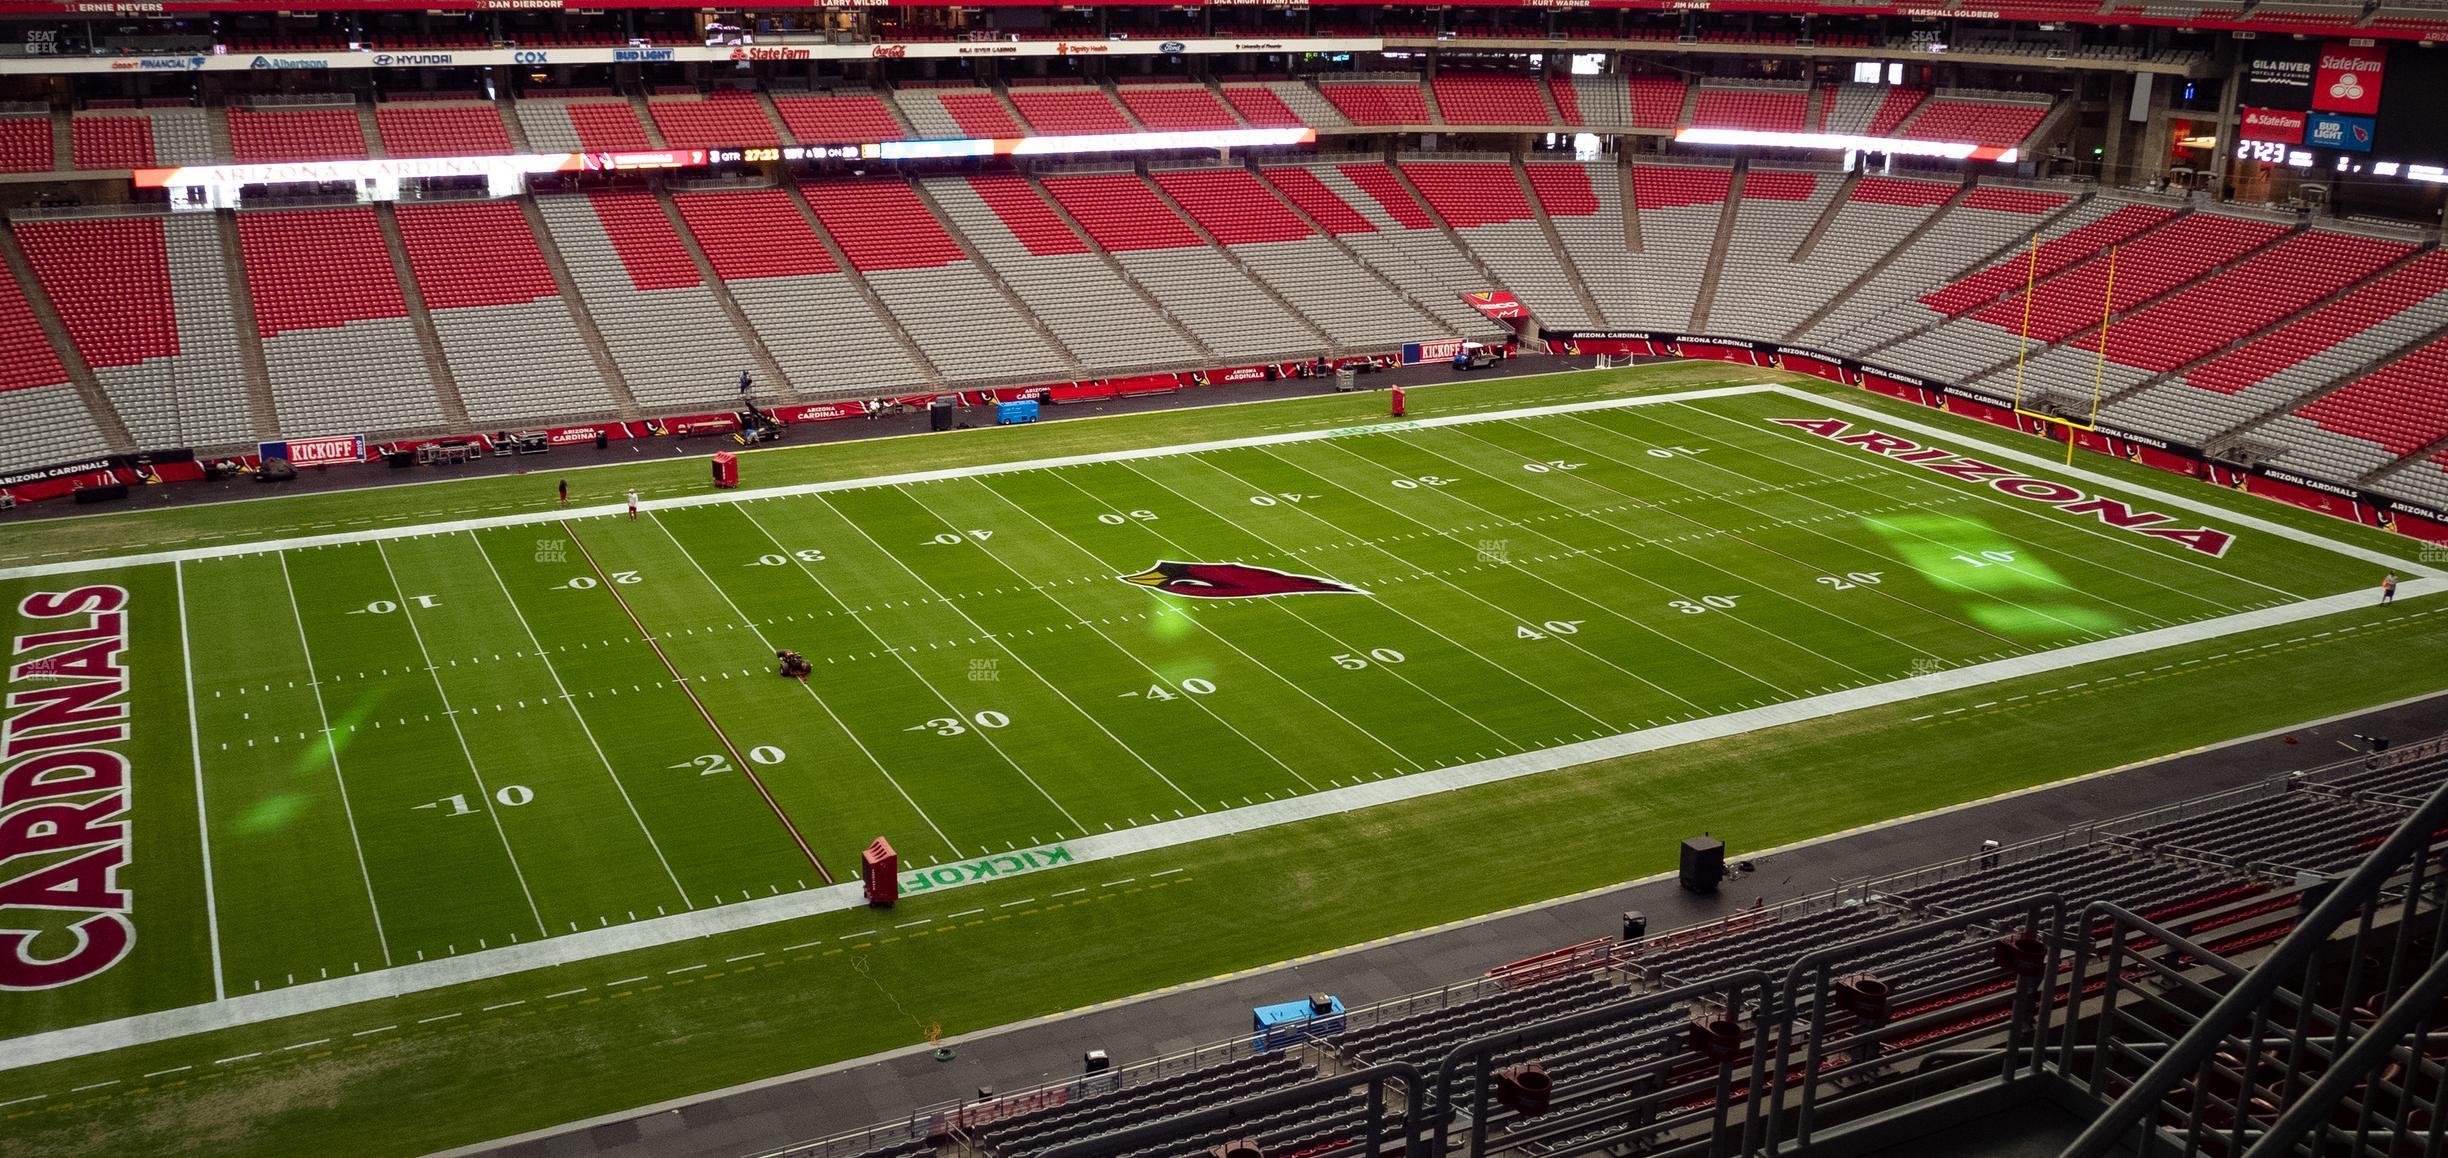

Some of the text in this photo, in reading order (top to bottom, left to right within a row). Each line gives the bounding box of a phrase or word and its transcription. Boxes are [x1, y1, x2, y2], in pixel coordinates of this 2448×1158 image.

[79, 3, 115, 12] ERNIE
[117, 3, 163, 12] NEVERS
[512, 0, 564, 8] DIERDORF
[1907, 8, 1953, 17] MARSHALL
[1954, 9, 2000, 18] GOLDBERG
[1070, 45, 1089, 53] Dignity
[1164, 43, 1181, 51] Ford
[396, 54, 452, 63] HYUNDAI
[514, 51, 548, 62] COX
[616, 51, 672, 61] BUD LIGHT
[140, 60, 186, 70] FINANCIAL
[272, 57, 328, 69] Albertsons
[2252, 60, 2311, 72] GILA RIVER
[2319, 122, 2341, 131] BUD
[2314, 129, 2344, 139] LIGHT
[721, 152, 741, 162] QTR
[744, 149, 780, 161] 27:23
[2237, 140, 2286, 163] 27:23
[211, 163, 341, 183] ARIZONA
[1676, 336, 1753, 348] ARIZONA CARDINALS
[1422, 343, 1461, 358] KICKOFF
[1777, 347, 1842, 364] ARIZONA CARDINALS
[1225, 372, 1265, 381] CARDINALS
[1861, 365, 1923, 386] ARIZONA CARDINALS
[1944, 386, 2012, 408] ARIZONA CARDINALS
[797, 409, 846, 420] CARDINALS
[806, 406, 837, 414] ARIZONA
[2123, 433, 2168, 449] CARDINALS
[292, 440, 352, 462] KICKOFF
[0, 460, 110, 486] ARIZONA CARDINALS
[1768, 417, 2235, 558] ARIZONA
[2264, 468, 2358, 498] ARIZONA CARDINALS
[2390, 502, 2435, 519] ARIZONA
[0, 584, 136, 992] CARDINALS
[897, 846, 1075, 894] KICKOF
